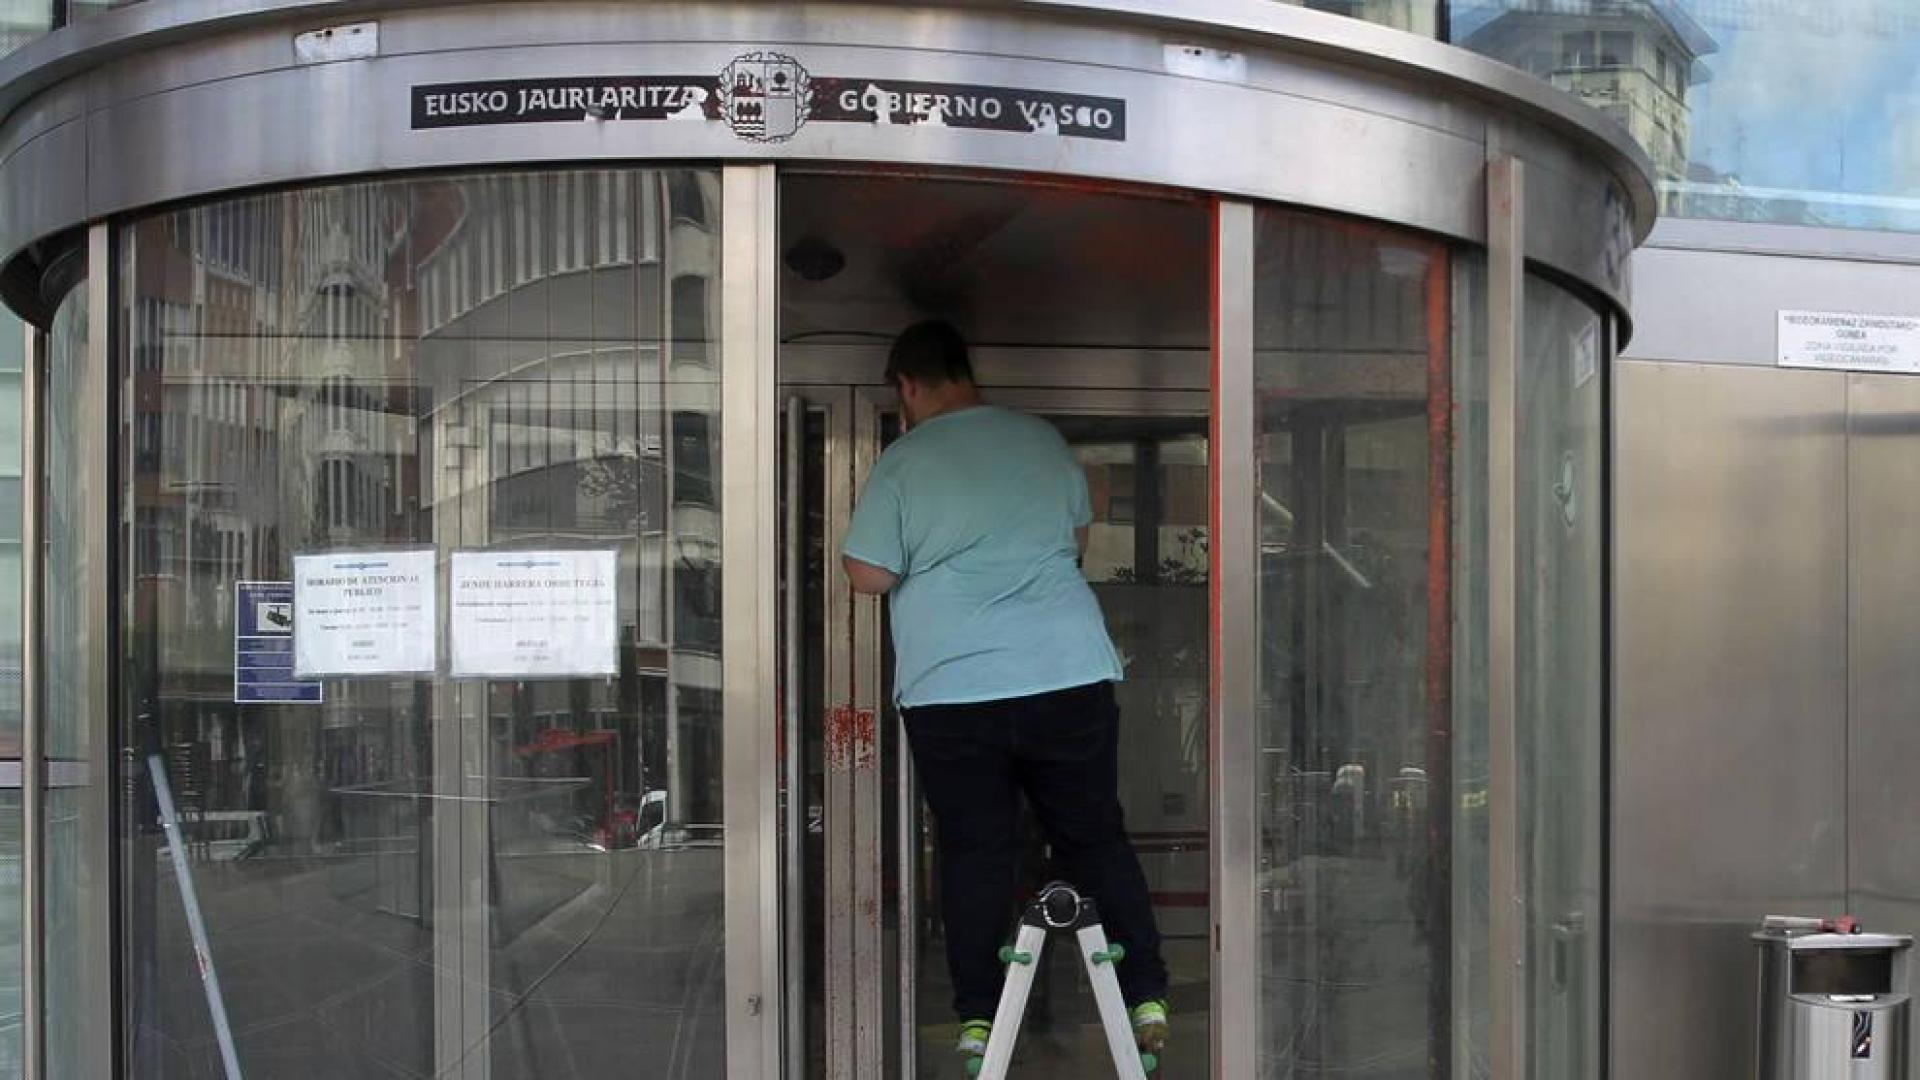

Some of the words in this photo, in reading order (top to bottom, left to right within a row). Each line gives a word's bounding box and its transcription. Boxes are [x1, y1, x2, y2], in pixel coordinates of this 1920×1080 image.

[424, 90, 508, 116] EUSKO
[516, 86, 704, 116] JAURLARITZA
[839, 89, 1001, 119] GOBIERNO
